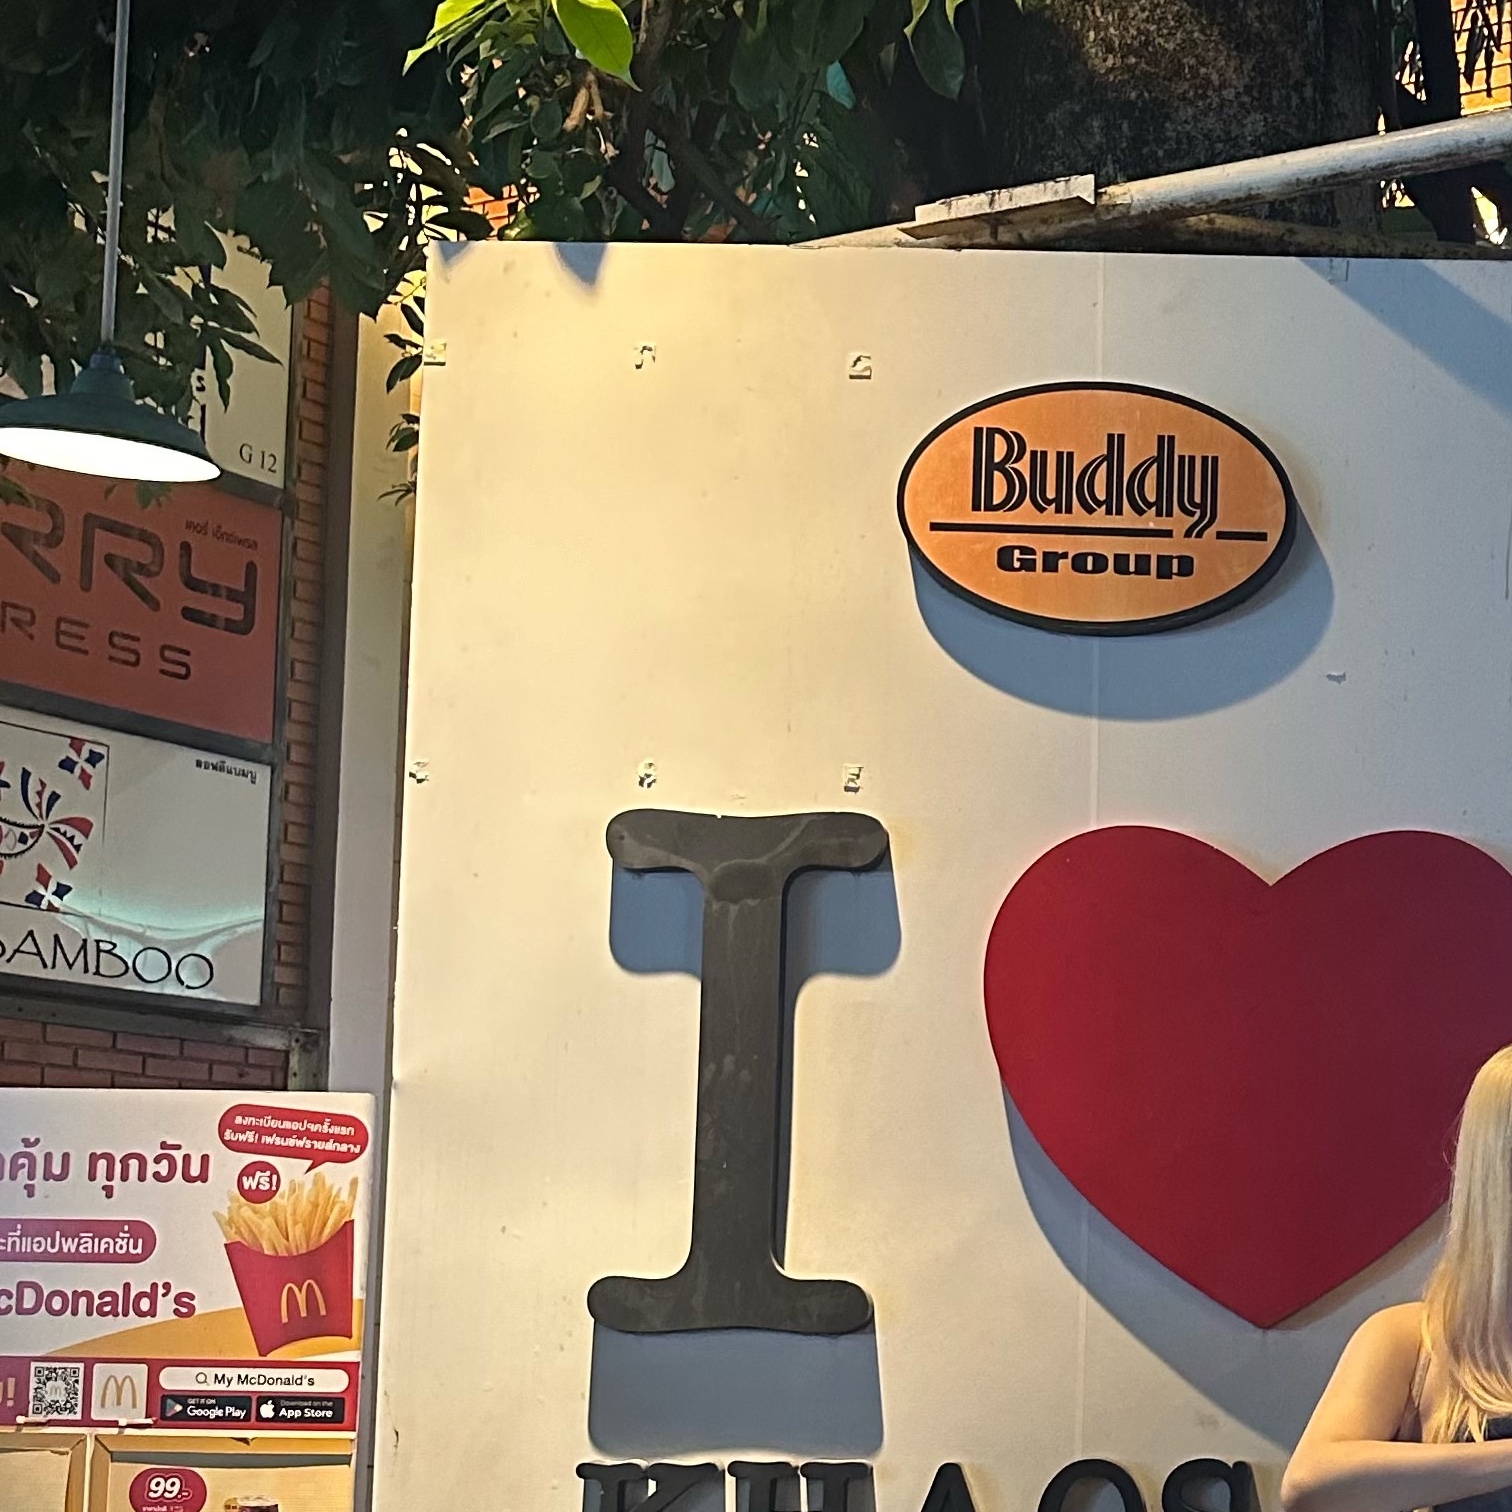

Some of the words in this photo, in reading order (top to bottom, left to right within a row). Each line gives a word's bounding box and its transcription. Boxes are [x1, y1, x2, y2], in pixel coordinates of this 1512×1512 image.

[239, 443, 253, 464] G
[261, 451, 278, 474] 12
[970, 426, 1220, 539] Buddy
[996, 544, 1195, 580] Group
[0, 929, 214, 990] AMBOO
[587, 808, 890, 1335] I
[0, 1137, 71, 1199] คุ้ม
[87, 1141, 210, 1199] ทุกวัน
[242, 1169, 278, 1192] ฟรี!
[213, 1373, 234, 1388] My
[236, 1373, 316, 1387] McDonald's
[187, 1405, 224, 1420] Google
[225, 1406, 247, 1420] Play
[278, 1408, 302, 1419] App
[303, 1408, 334, 1419] Store
